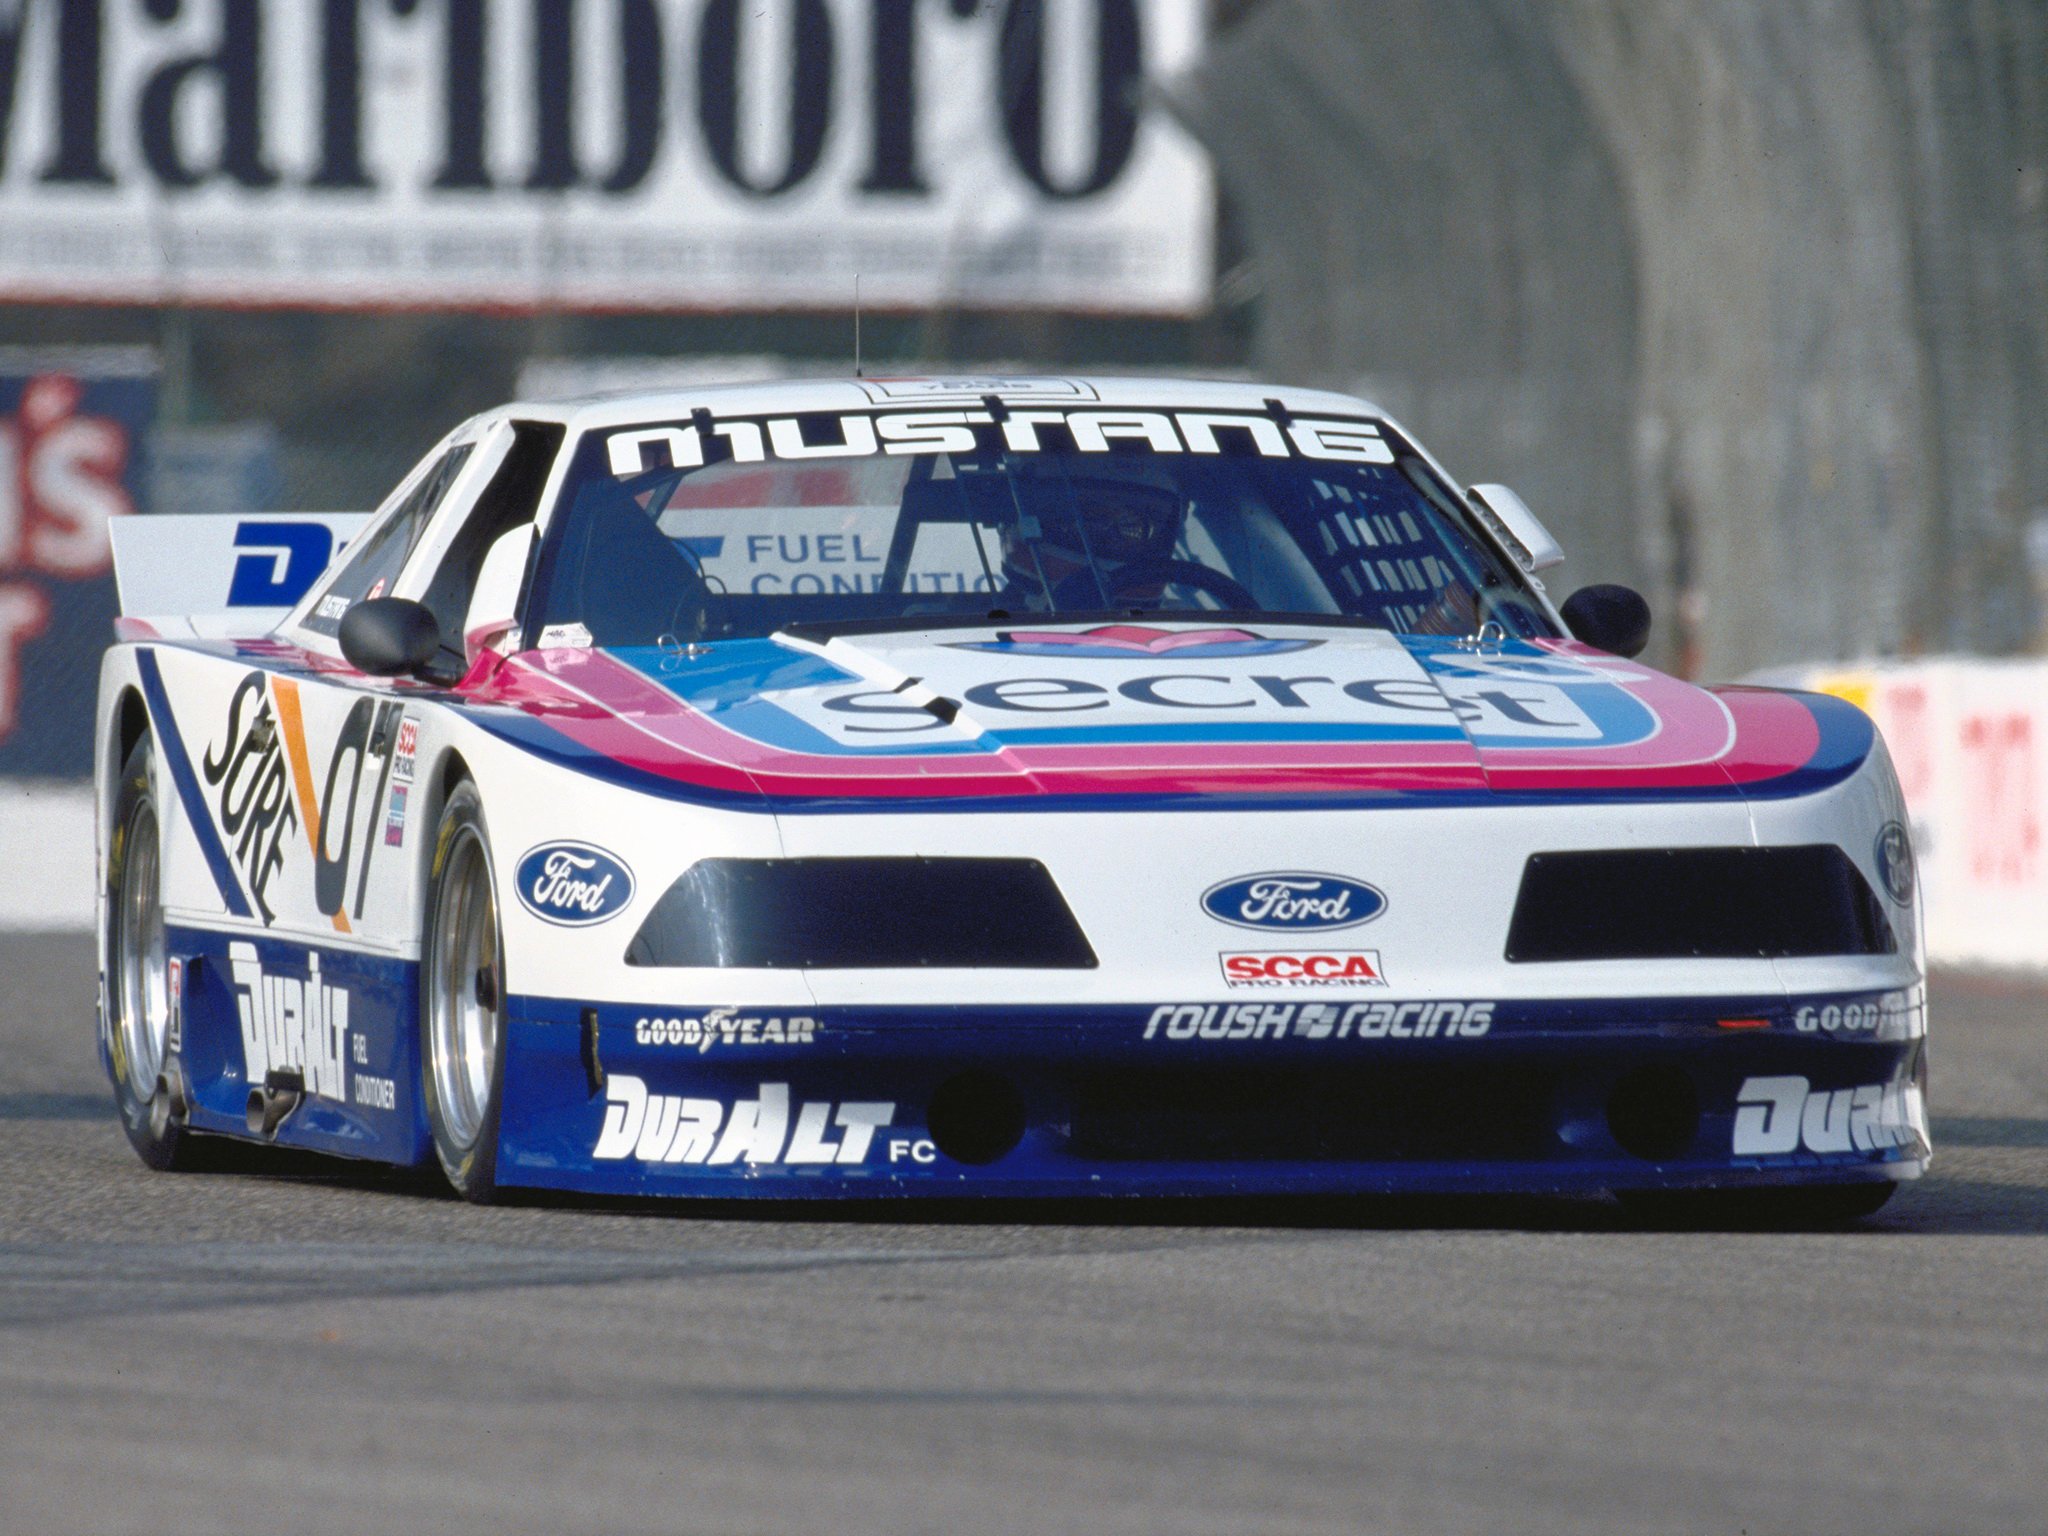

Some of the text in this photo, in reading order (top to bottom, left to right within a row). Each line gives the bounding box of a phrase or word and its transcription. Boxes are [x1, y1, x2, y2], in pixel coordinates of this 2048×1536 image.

[606, 410, 1394, 474] MUSTANG
[747, 534, 882, 563] FUEL
[397, 721, 418, 757] SCCA
[533, 850, 613, 913] Ford
[1240, 880, 1351, 920] Ford
[1226, 955, 1379, 980] SCCA
[1230, 978, 1385, 988] PRO RACING
[353, 1032, 369, 1065] FUEL
[355, 1073, 395, 1111] CONDITIONER
[888, 1139, 937, 1162] FC
